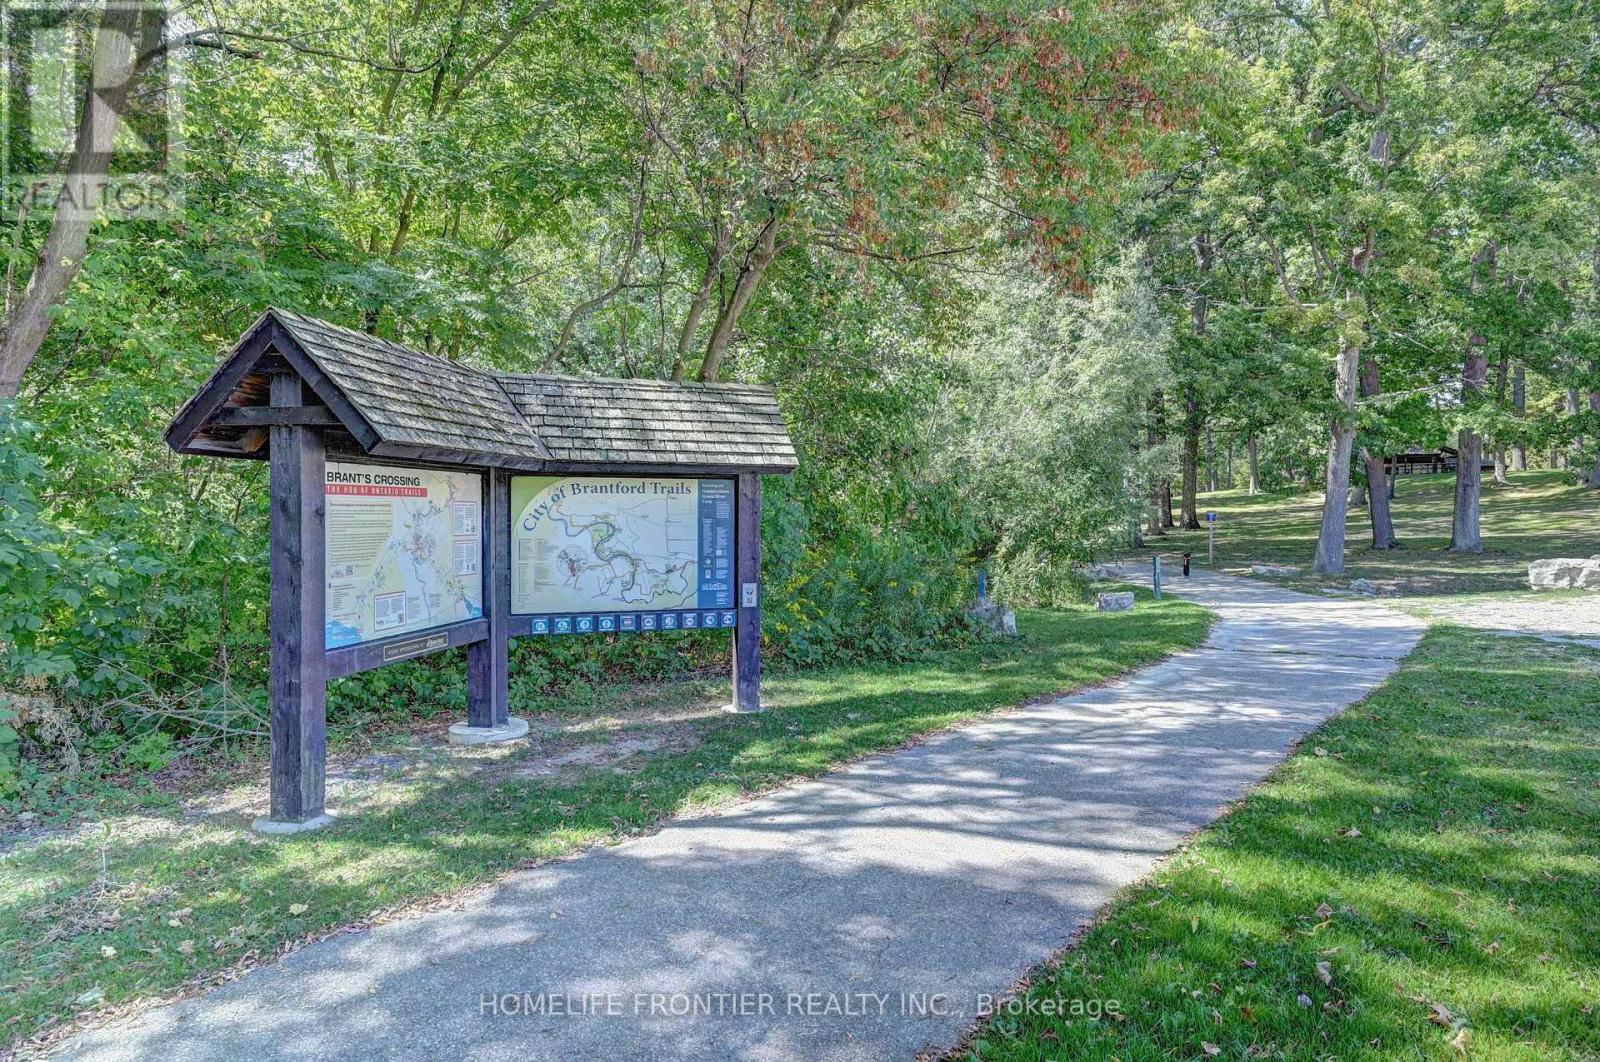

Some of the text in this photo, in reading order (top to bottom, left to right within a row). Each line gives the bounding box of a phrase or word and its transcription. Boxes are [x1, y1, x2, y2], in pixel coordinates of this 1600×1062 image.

[326, 472, 421, 486] BRANT'S CROSSING
[326, 485, 340, 494] THE
[522, 481, 692, 531] City of Brantford Trails
